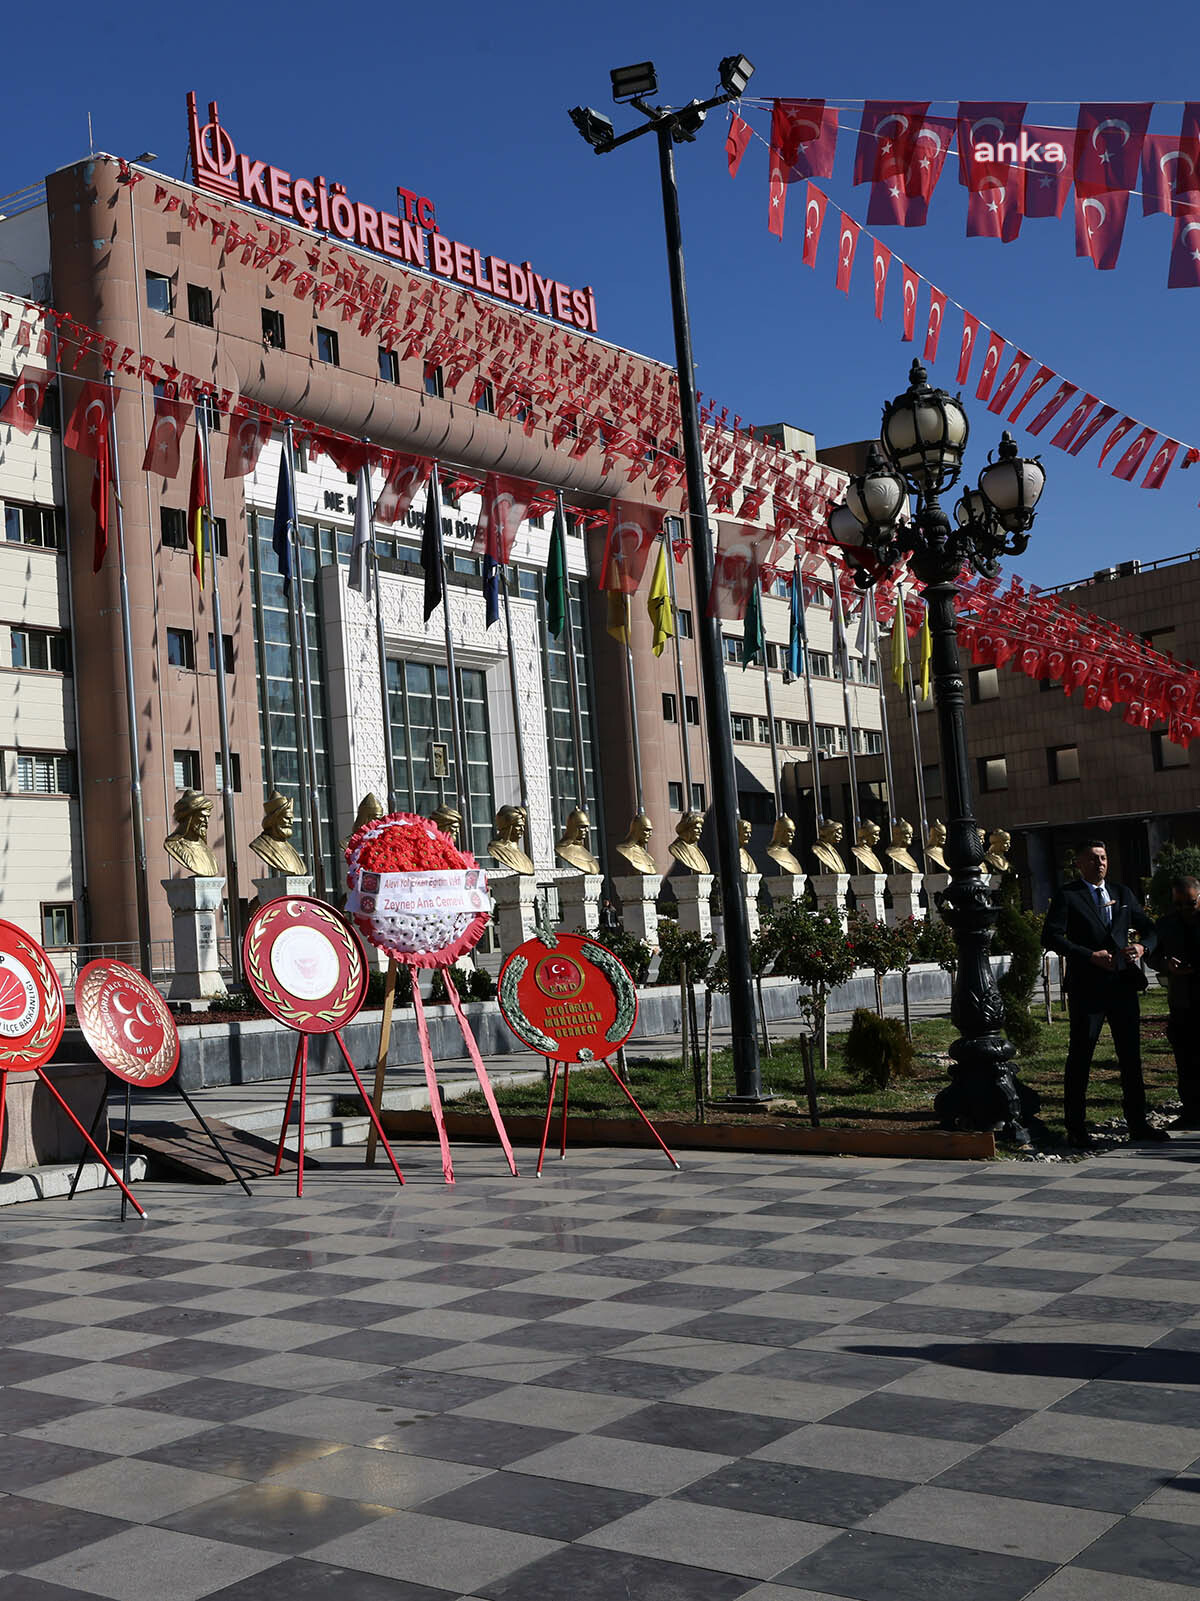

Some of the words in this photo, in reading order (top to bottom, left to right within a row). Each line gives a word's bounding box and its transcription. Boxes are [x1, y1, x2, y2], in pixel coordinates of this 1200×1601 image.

[397, 186, 440, 232] T.C.
[239, 153, 426, 267] KEÇİÖREN
[429, 231, 598, 332] BELEDİYESİ
[323, 490, 345, 513] NE
[384, 899, 415, 912] Zeynep
[417, 897, 434, 908] Ana
[3, 1022, 20, 1034] İLÇE
[18, 980, 36, 1030] BAŞKANLIĞI
[136, 1045, 153, 1055] MHP
